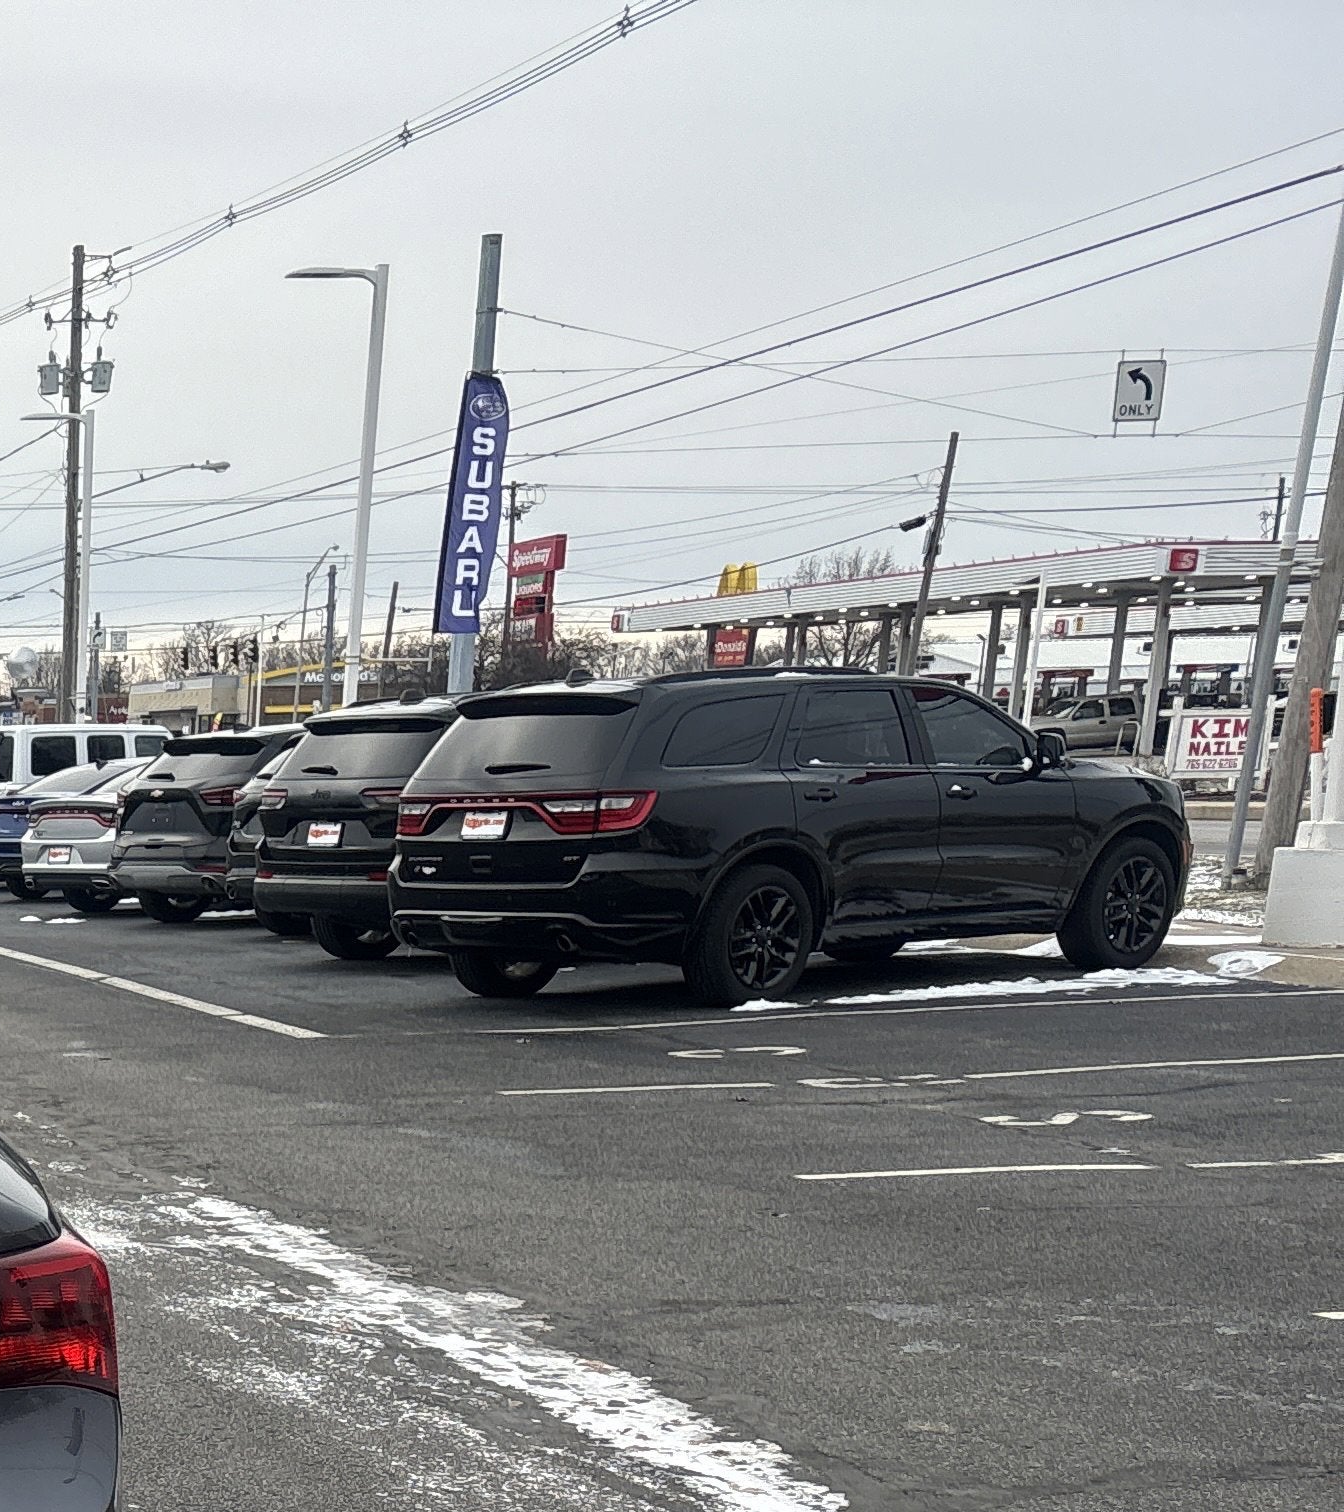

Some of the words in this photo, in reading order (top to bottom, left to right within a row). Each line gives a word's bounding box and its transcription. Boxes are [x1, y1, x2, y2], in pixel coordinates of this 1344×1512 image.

[1119, 404, 1154, 416] ONLY
[451, 427, 497, 617] SUBARU
[512, 546, 552, 571] Speedway
[1190, 718, 1250, 739] KIM
[1188, 740, 1246, 757] NAILS
